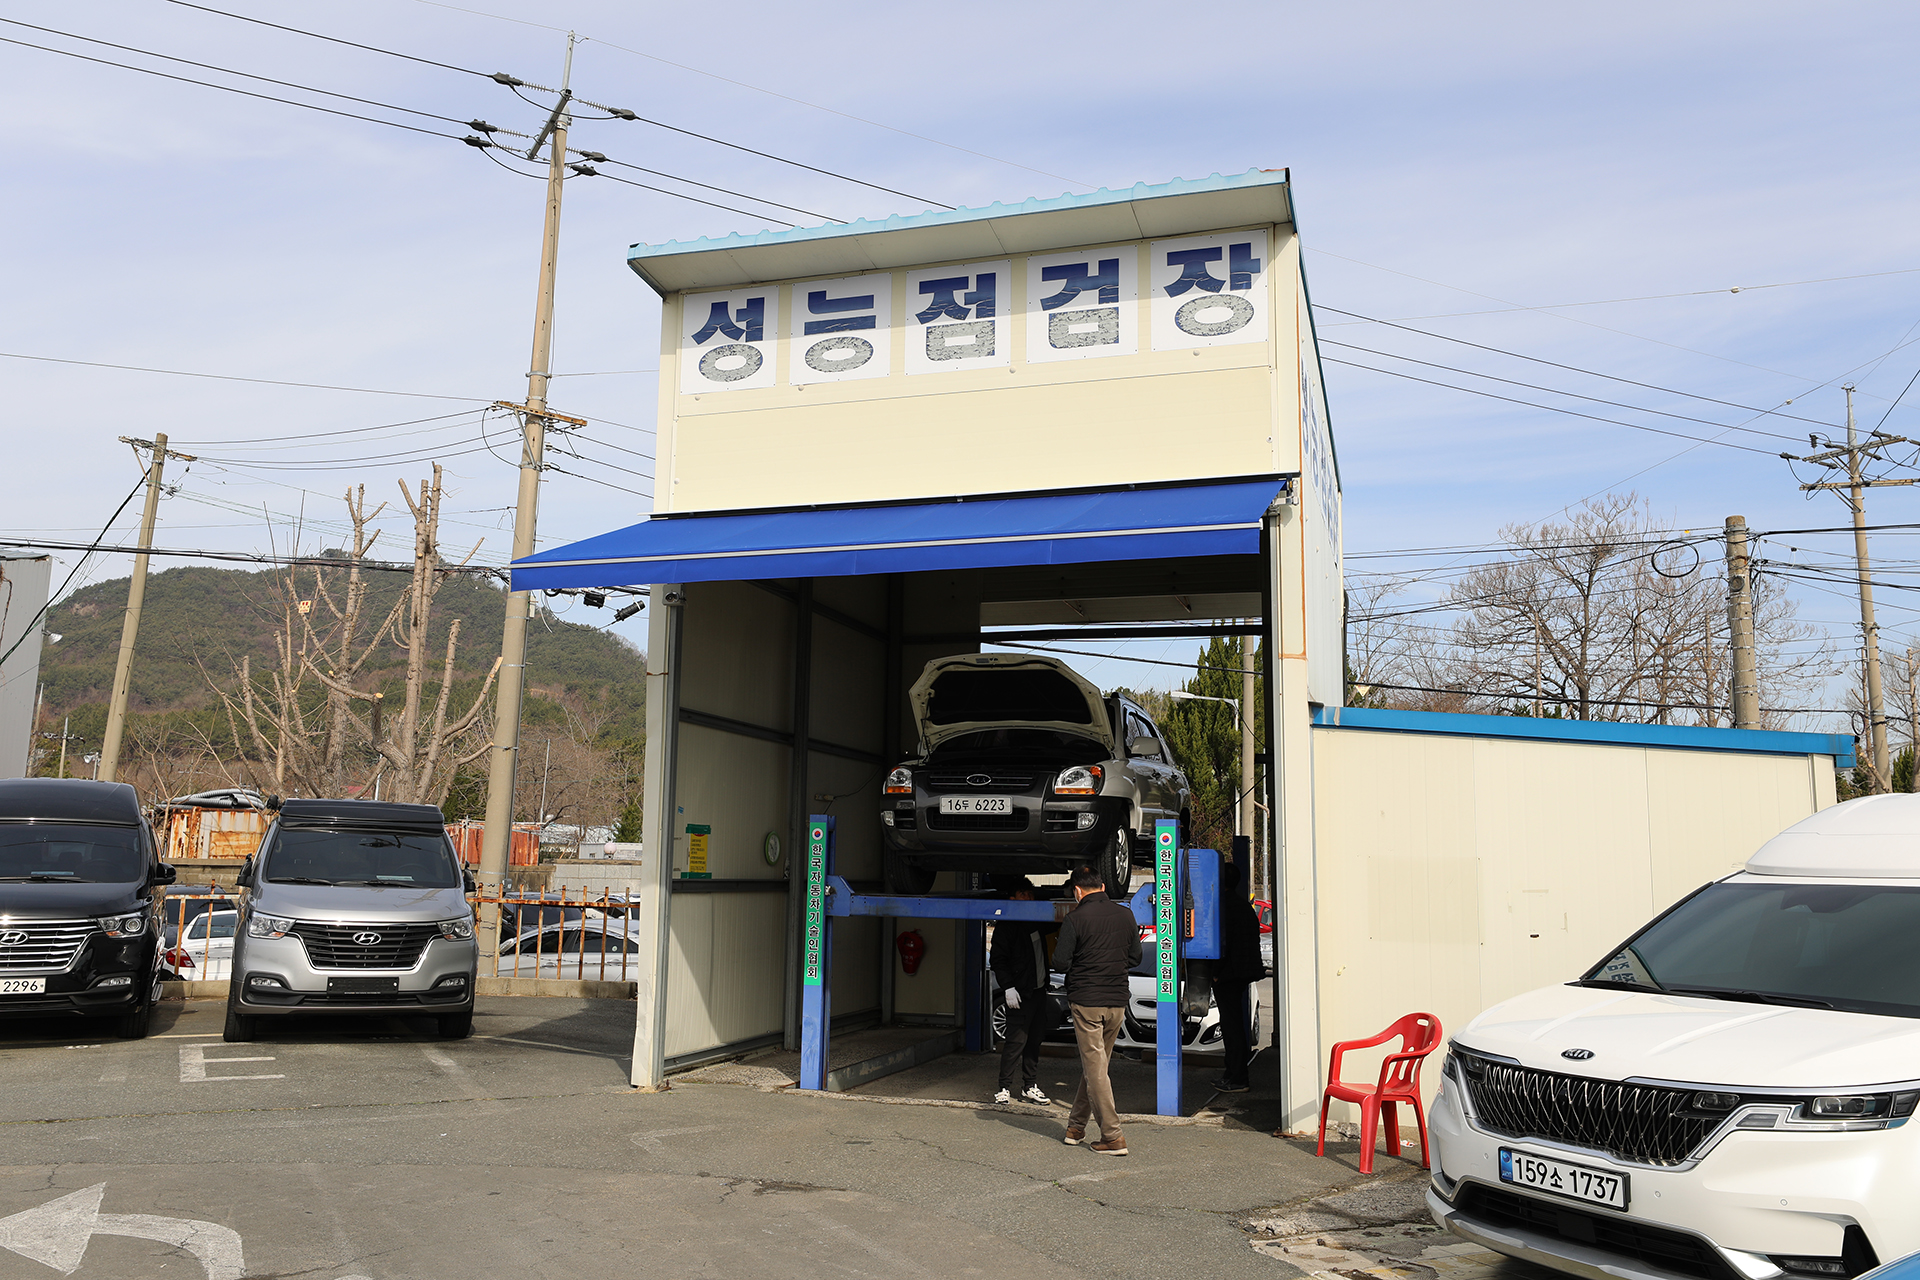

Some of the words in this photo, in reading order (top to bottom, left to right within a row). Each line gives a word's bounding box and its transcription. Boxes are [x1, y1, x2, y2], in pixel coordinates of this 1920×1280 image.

[691, 242, 1261, 383] 성능점검장
[948, 799, 969, 811] 16두
[975, 799, 1005, 811] 6223
[806, 843, 823, 979] 한국자동차기술인협회
[1159, 849, 1173, 995] 한국자동차기술인협회
[3, 980, 39, 993] 2296
[1565, 1049, 1590, 1059] KIA
[1515, 1157, 1563, 1190] 159소
[1569, 1169, 1619, 1202] 1737
